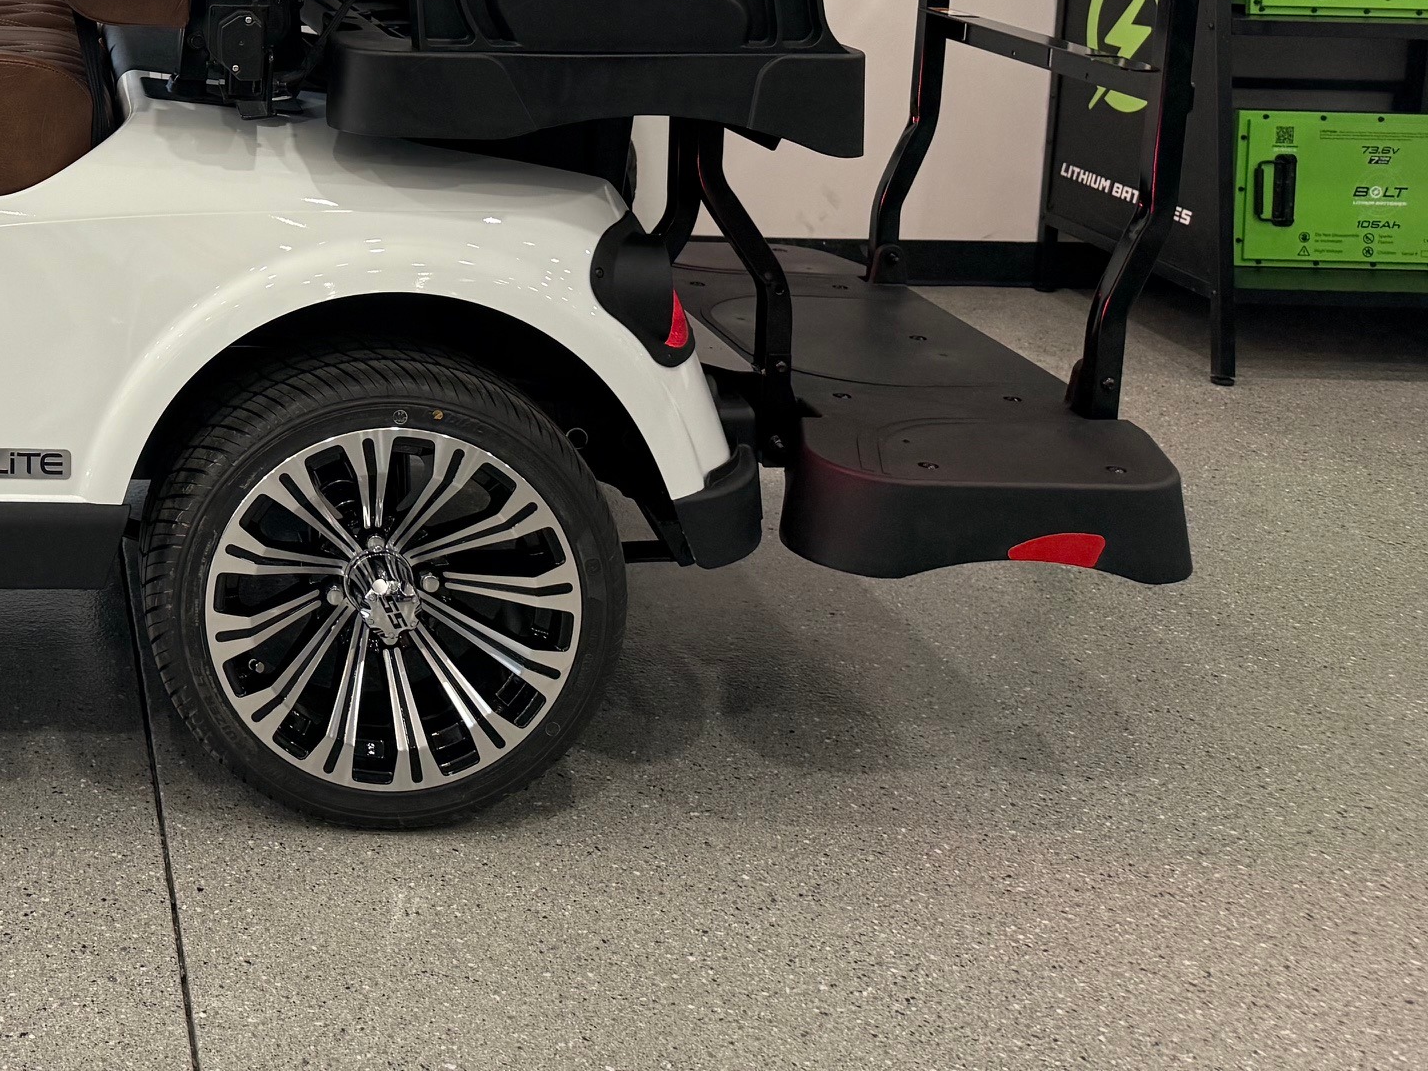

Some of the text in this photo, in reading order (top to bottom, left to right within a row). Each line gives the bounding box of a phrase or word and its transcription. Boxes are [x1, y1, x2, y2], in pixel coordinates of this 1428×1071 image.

[1060, 163, 1192, 225] LITHIUM BATES
[1353, 186, 1408, 198] BOLT
[1357, 220, 1401, 229] 105Ah
